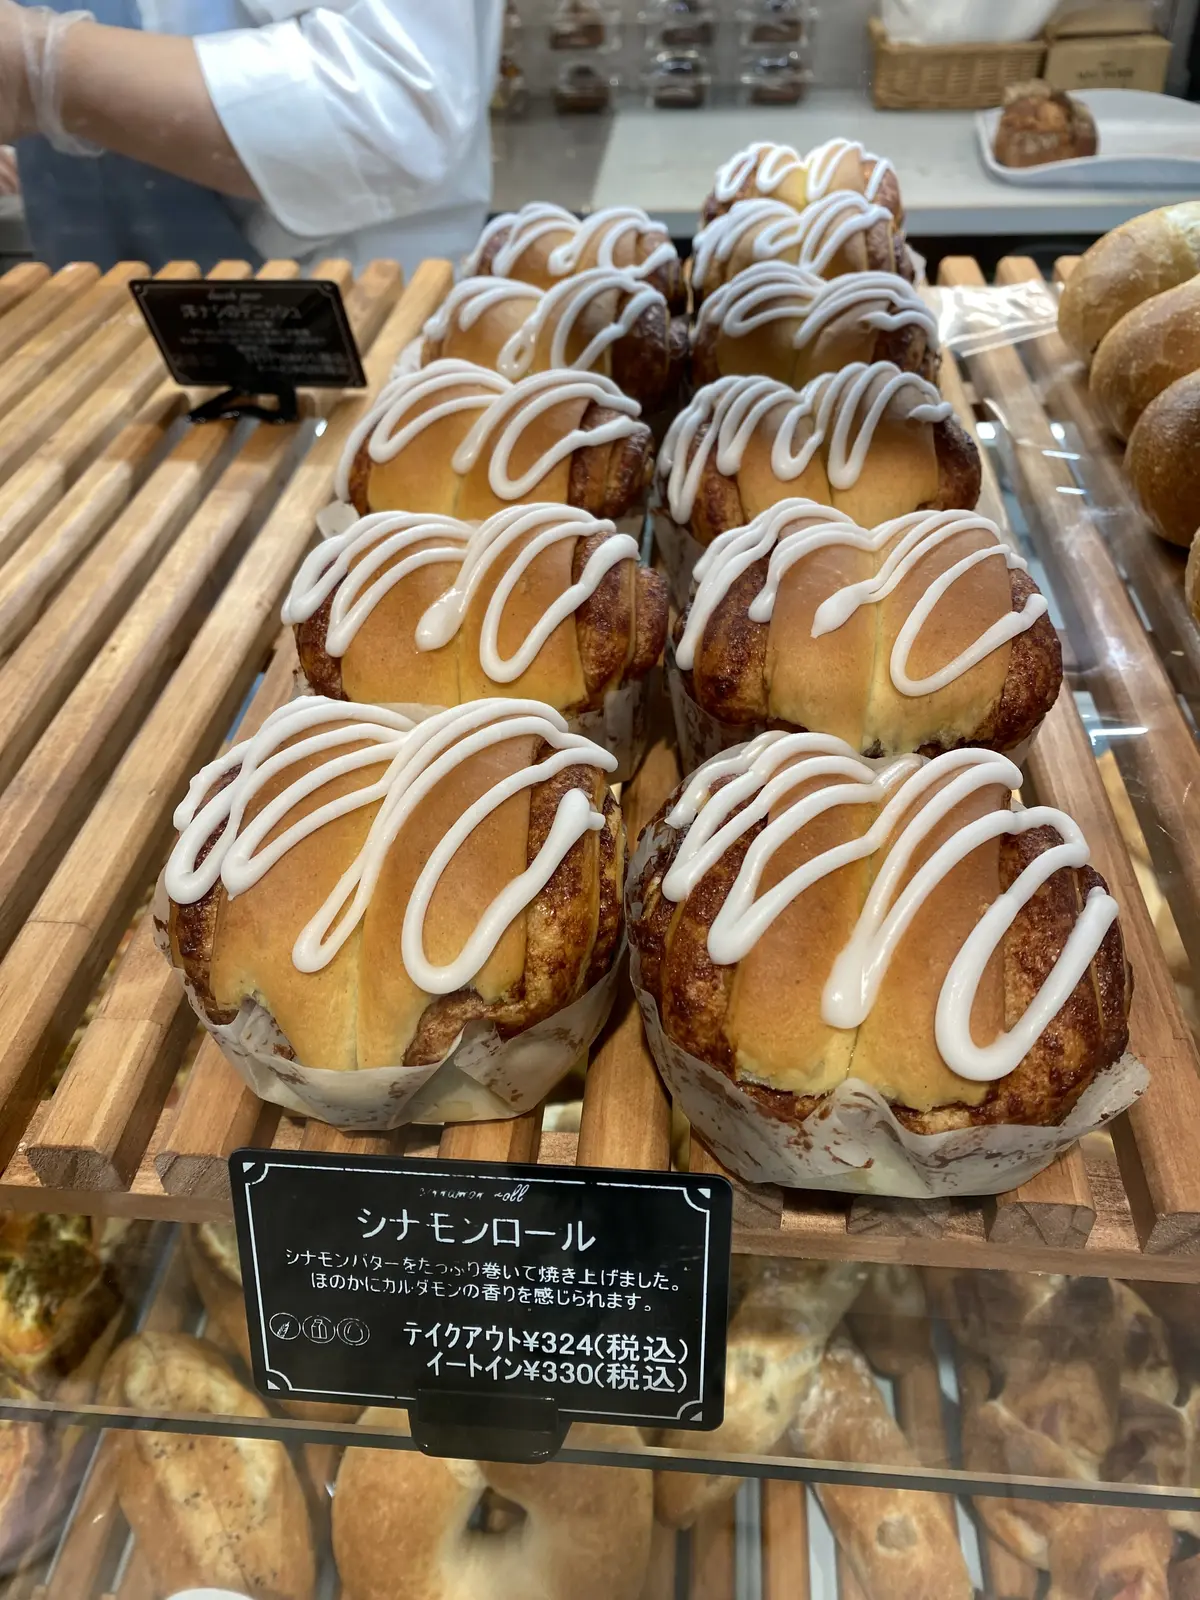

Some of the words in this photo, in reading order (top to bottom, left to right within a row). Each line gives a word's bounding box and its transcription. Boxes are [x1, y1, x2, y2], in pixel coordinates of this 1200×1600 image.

[357, 1207, 597, 1252] シナモンロール
